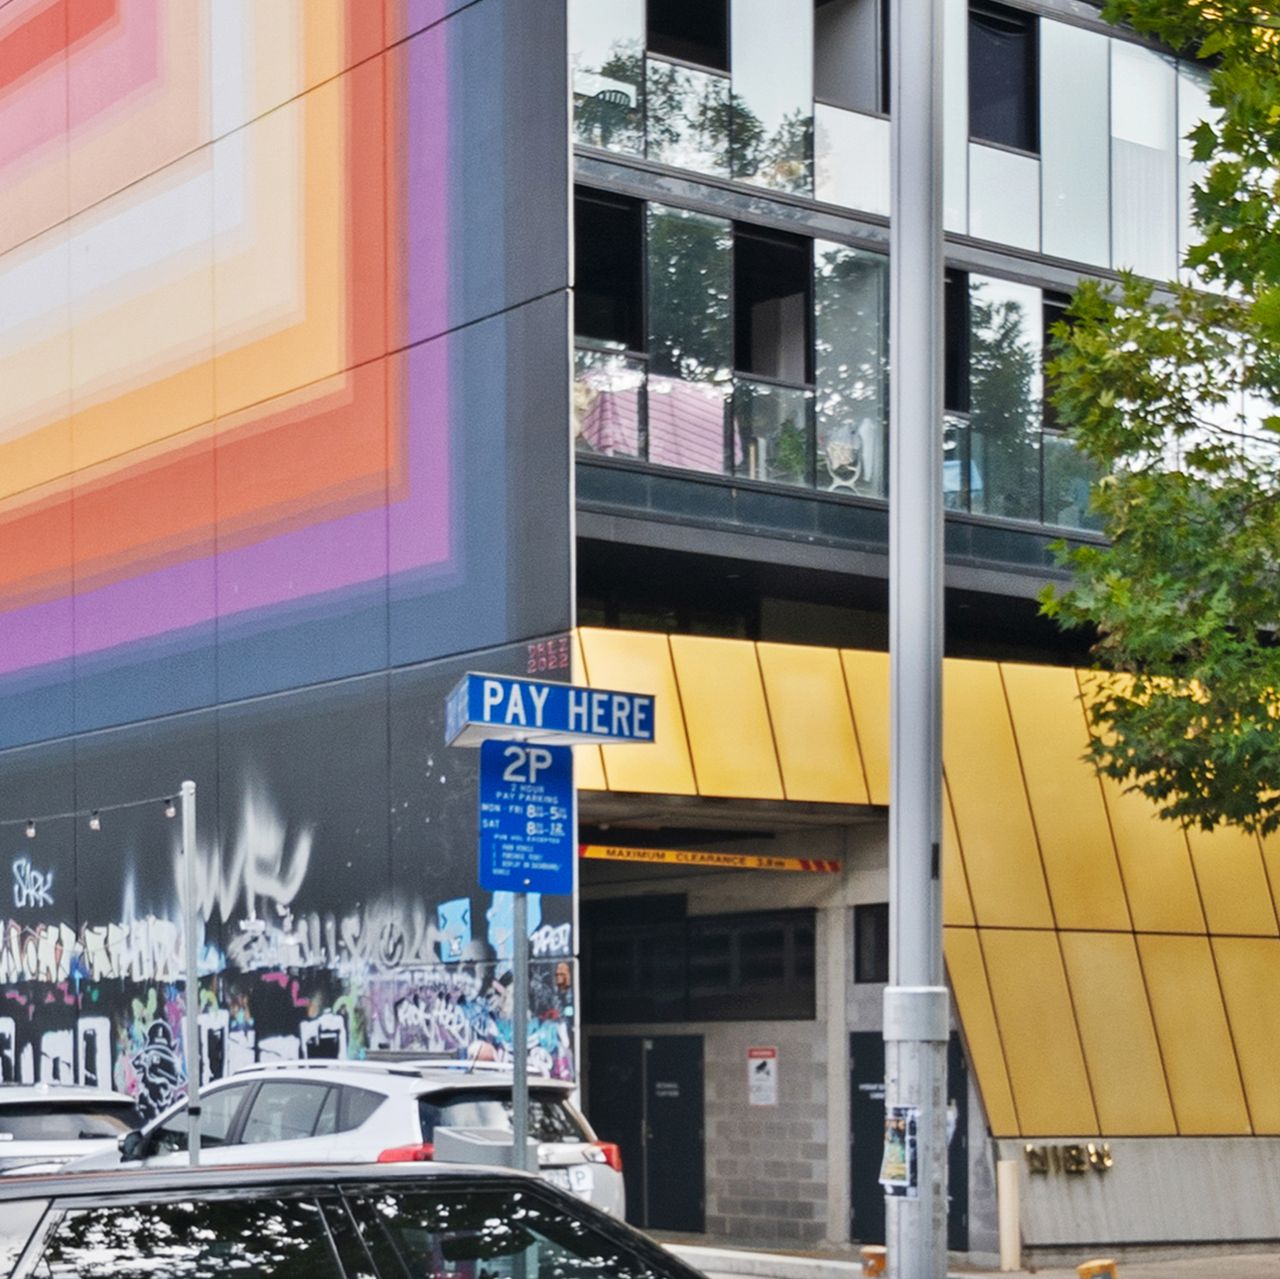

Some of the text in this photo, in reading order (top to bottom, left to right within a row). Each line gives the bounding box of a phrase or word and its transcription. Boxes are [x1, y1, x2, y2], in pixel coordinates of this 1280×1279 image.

[483, 680, 549, 727] PAY
[568, 690, 651, 738] HERE
[503, 746, 553, 784] 2P
[495, 791, 559, 805] PAY PARKING
[481, 803, 501, 813] MON
[482, 818, 500, 829] SAT
[606, 848, 665, 861] MAXIMUM
[675, 852, 746, 866] CLEARANCE
